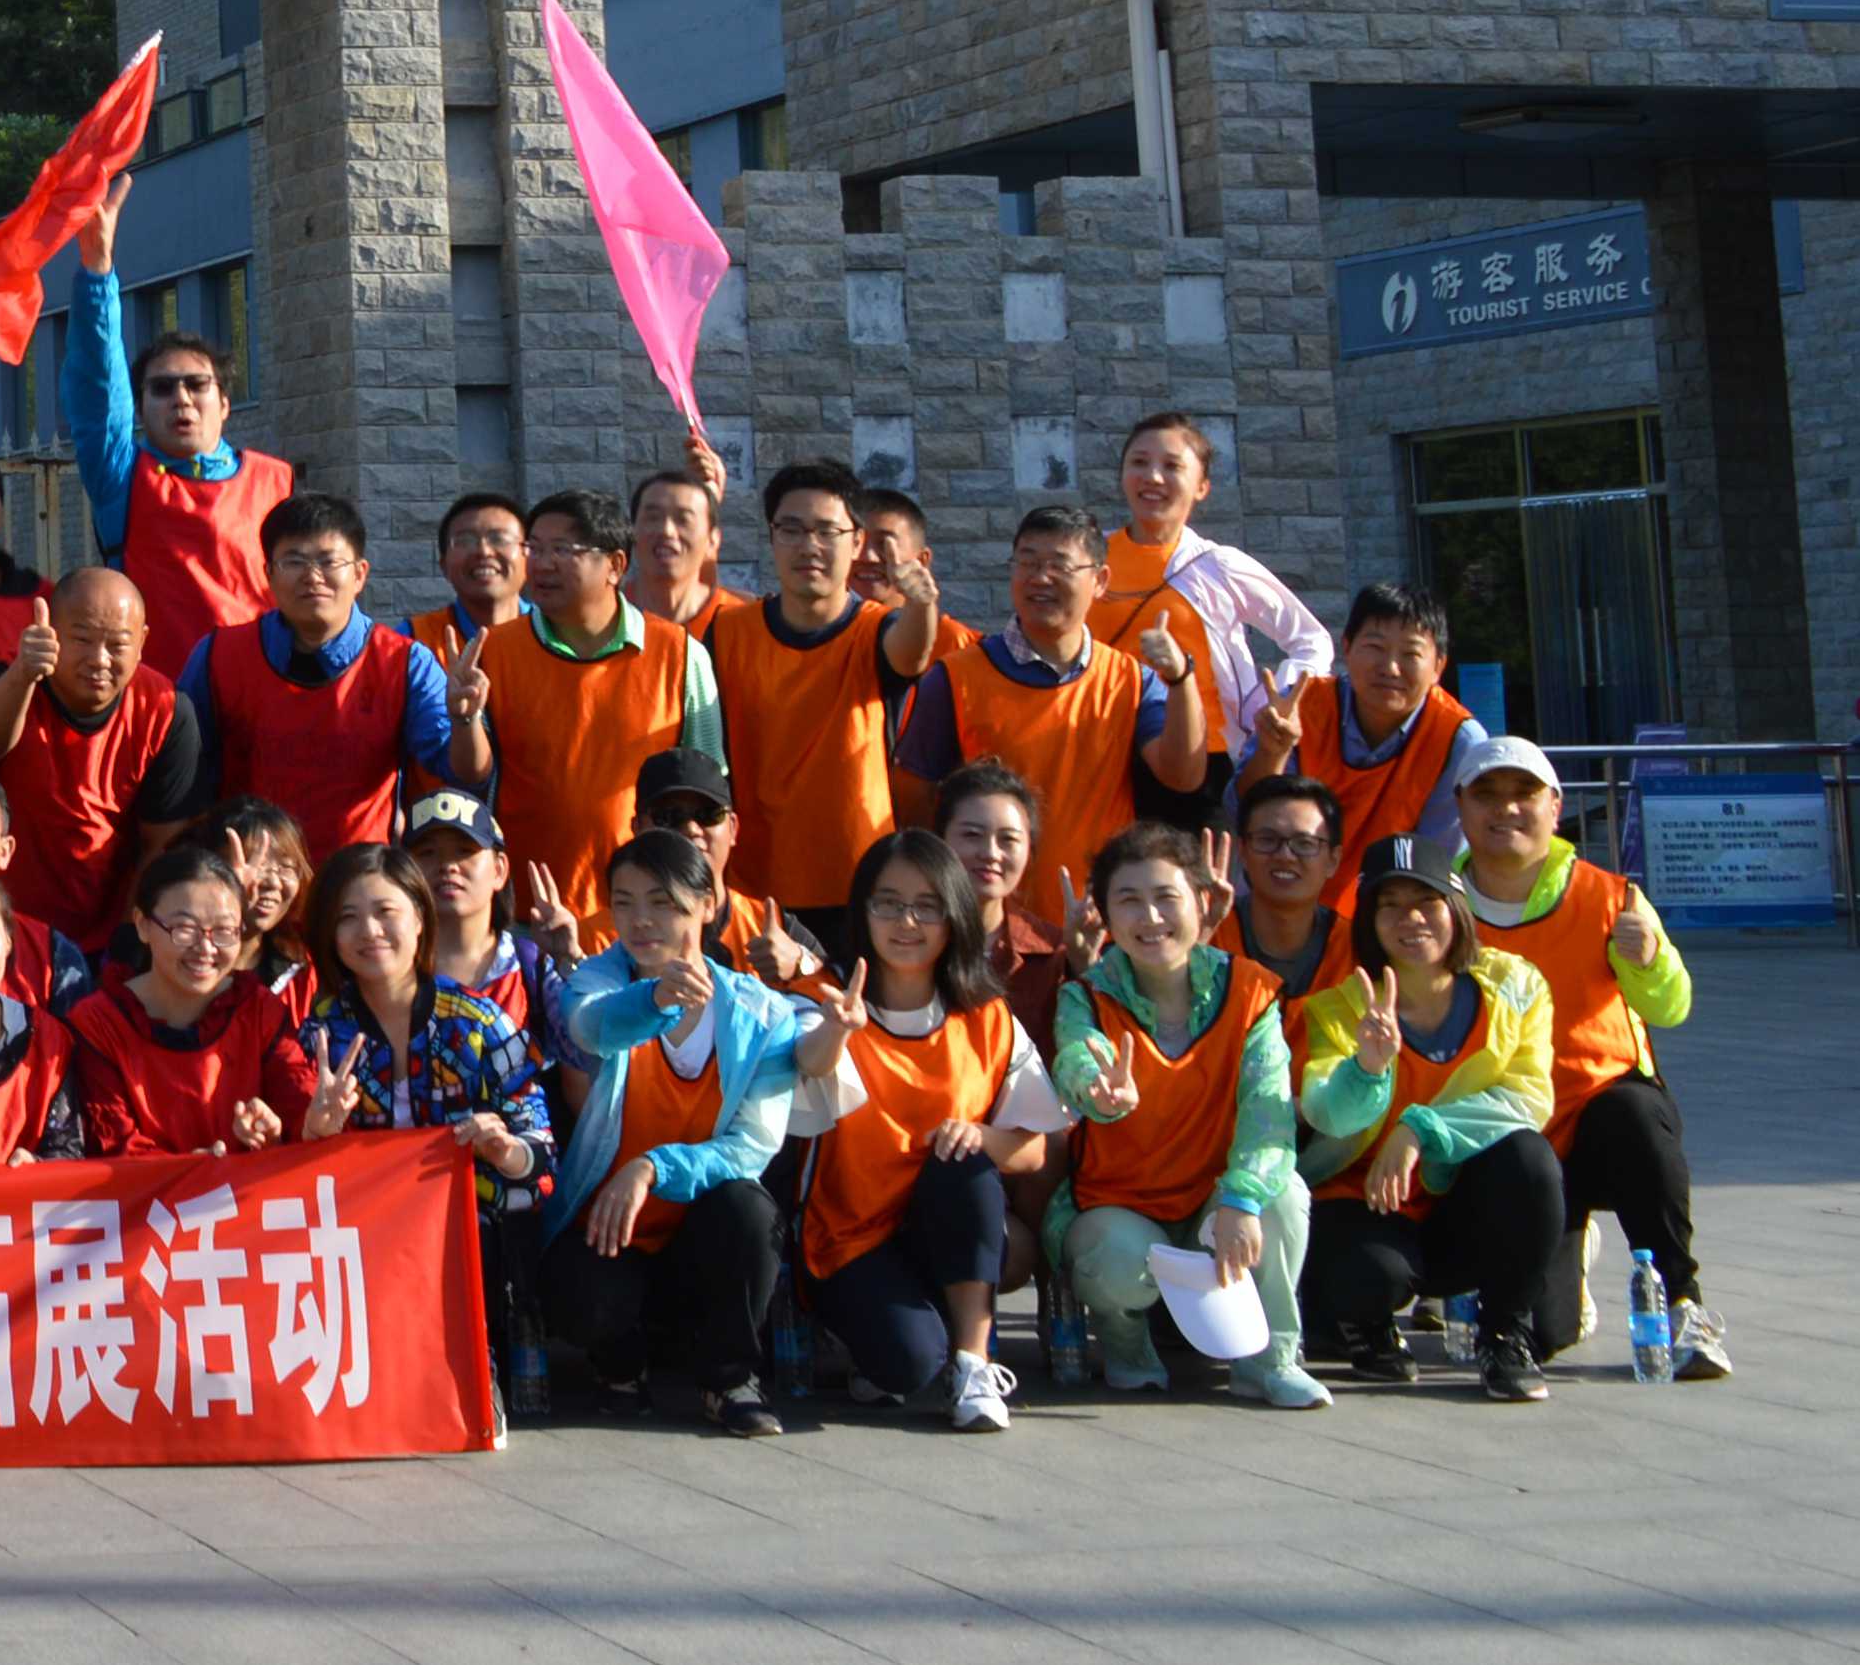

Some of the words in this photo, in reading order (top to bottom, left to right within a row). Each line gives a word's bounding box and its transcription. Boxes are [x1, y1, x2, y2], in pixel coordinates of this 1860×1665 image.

[1430, 231, 1624, 300] 游客服务
[1446, 296, 1531, 327] TOURIST
[1542, 280, 1629, 312] SERVICE
[412, 792, 479, 831] BOY
[1394, 838, 1413, 870] NY
